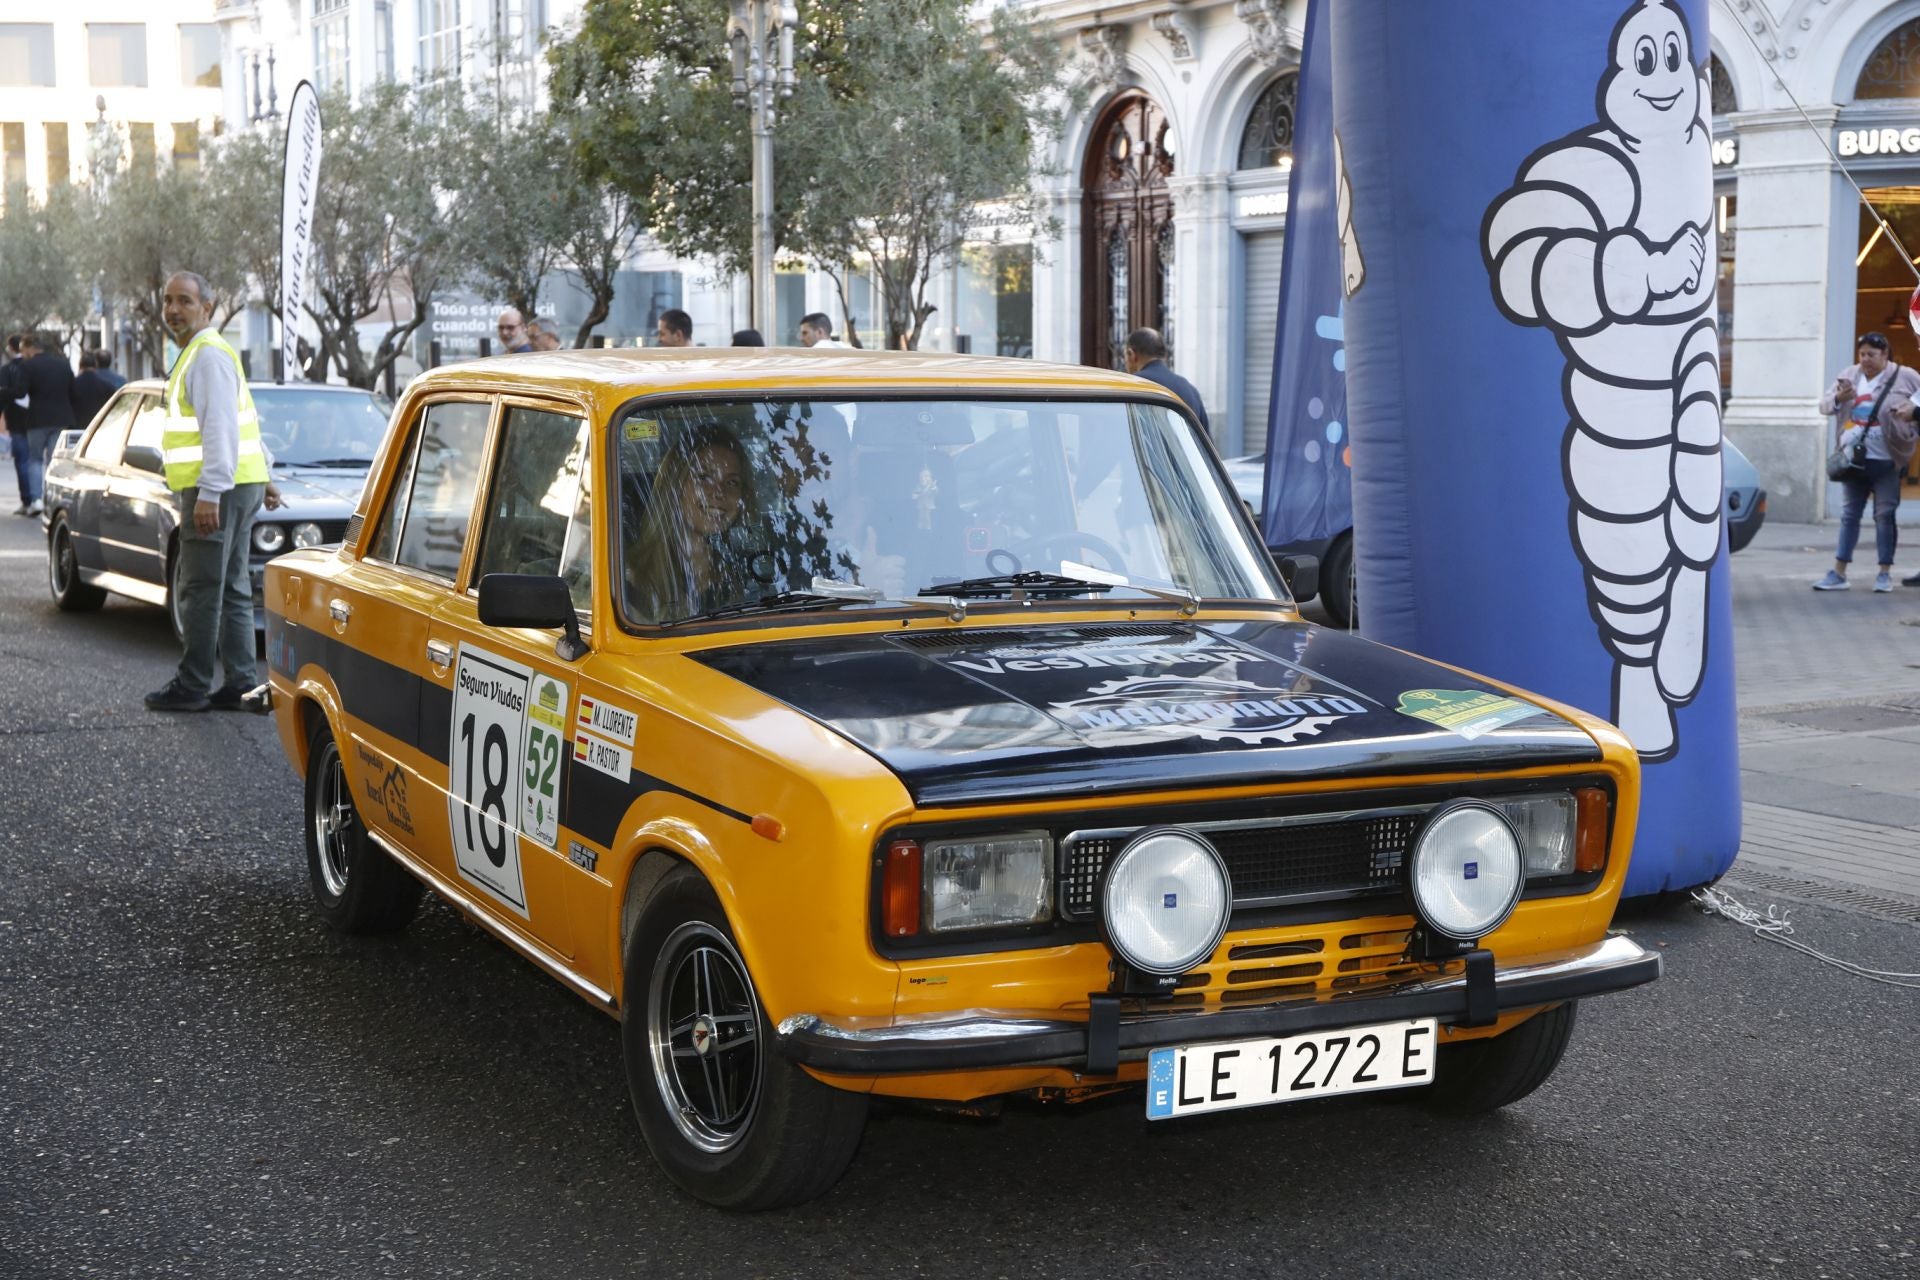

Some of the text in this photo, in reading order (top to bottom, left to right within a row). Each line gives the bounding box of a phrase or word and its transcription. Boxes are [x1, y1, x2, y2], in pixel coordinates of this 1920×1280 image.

[299, 100, 317, 206] Castilla
[1839, 127, 1920, 156] BURG
[295, 211, 308, 239] de
[286, 255, 303, 322] Norte
[432, 319, 486, 332] cuando
[470, 304, 488, 316] es
[460, 668, 522, 712] Segura Viudas
[593, 705, 634, 739] M. LLORENTE
[1076, 699, 1367, 728] MAKINAUTO
[525, 726, 559, 799] 52
[588, 742, 620, 774] R. PASTOR
[461, 713, 508, 868] 18
[568, 841, 597, 871] SEAT
[1178, 1027, 1430, 1106] LE 1272 E
[1156, 1090, 1167, 1106] E
